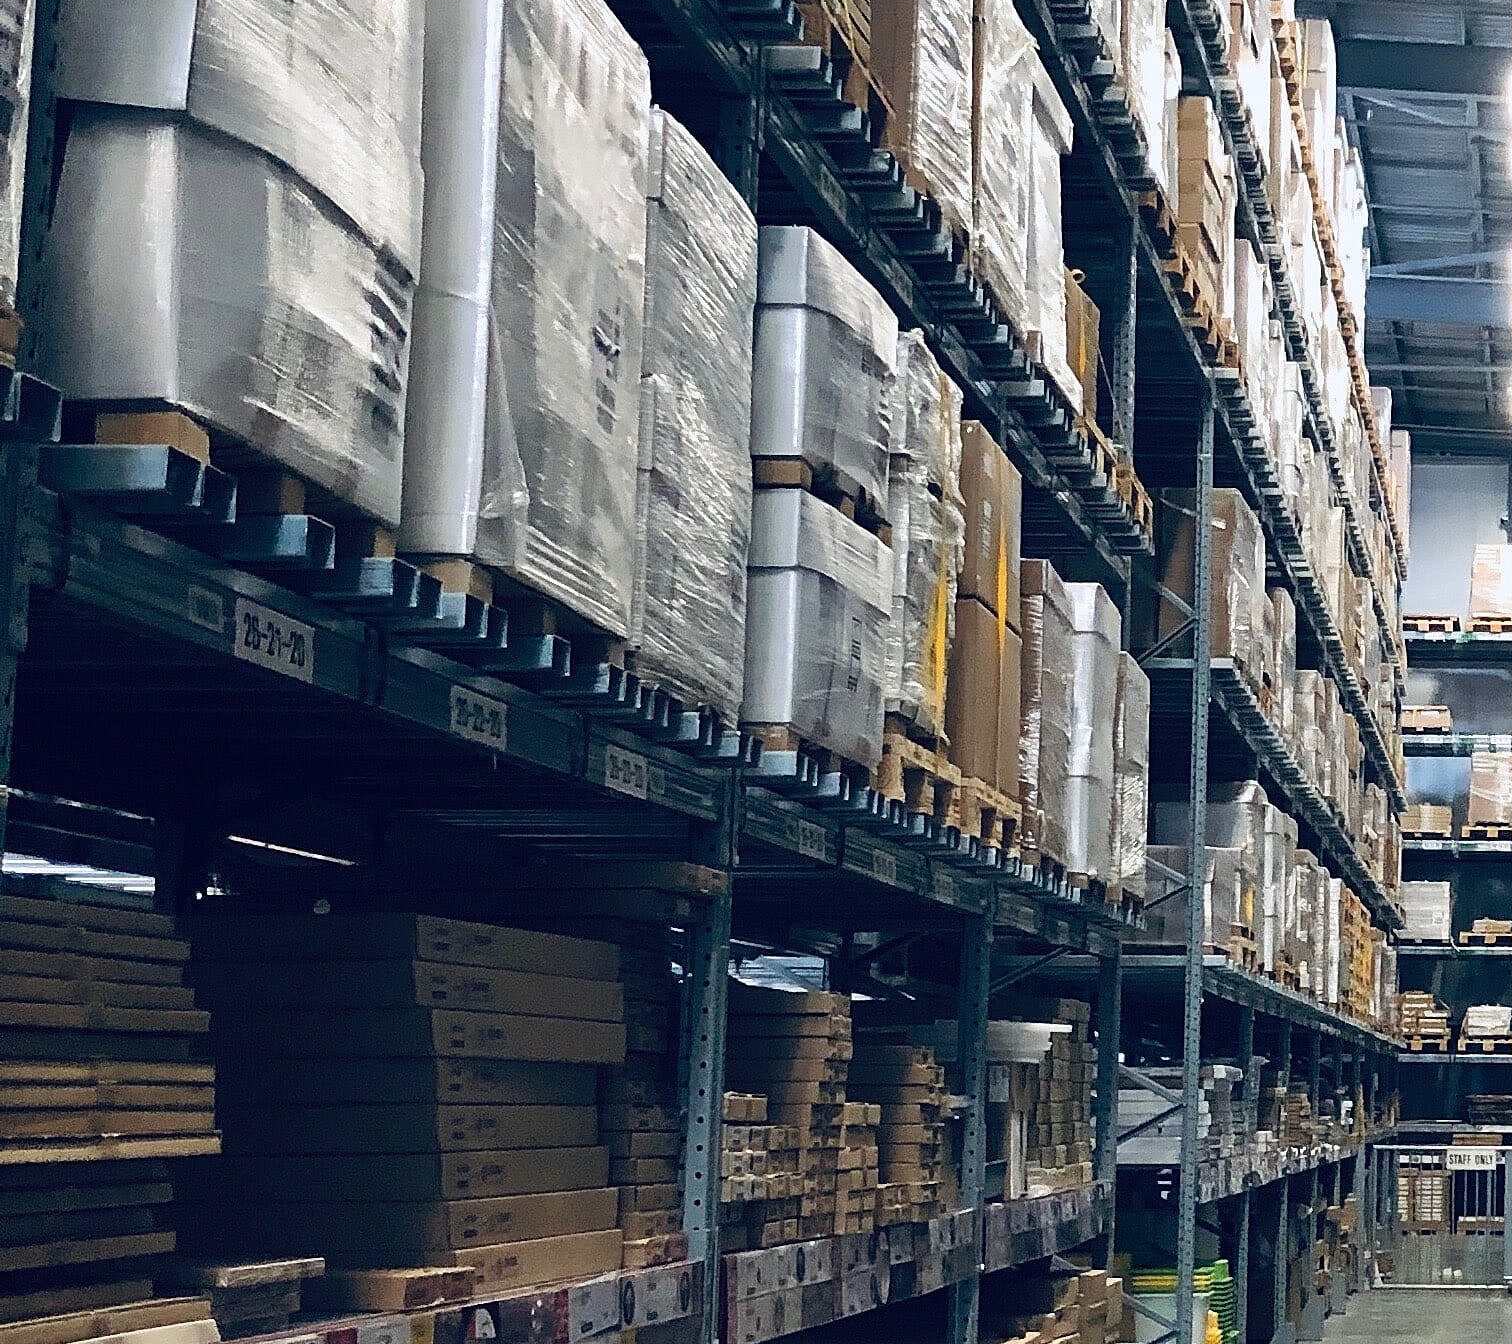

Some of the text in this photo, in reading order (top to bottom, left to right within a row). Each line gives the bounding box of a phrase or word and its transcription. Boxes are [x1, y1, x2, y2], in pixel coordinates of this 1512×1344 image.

[243, 611, 306, 667] 26-21-20
[1448, 1153, 1493, 1166] STAFF ONLY
